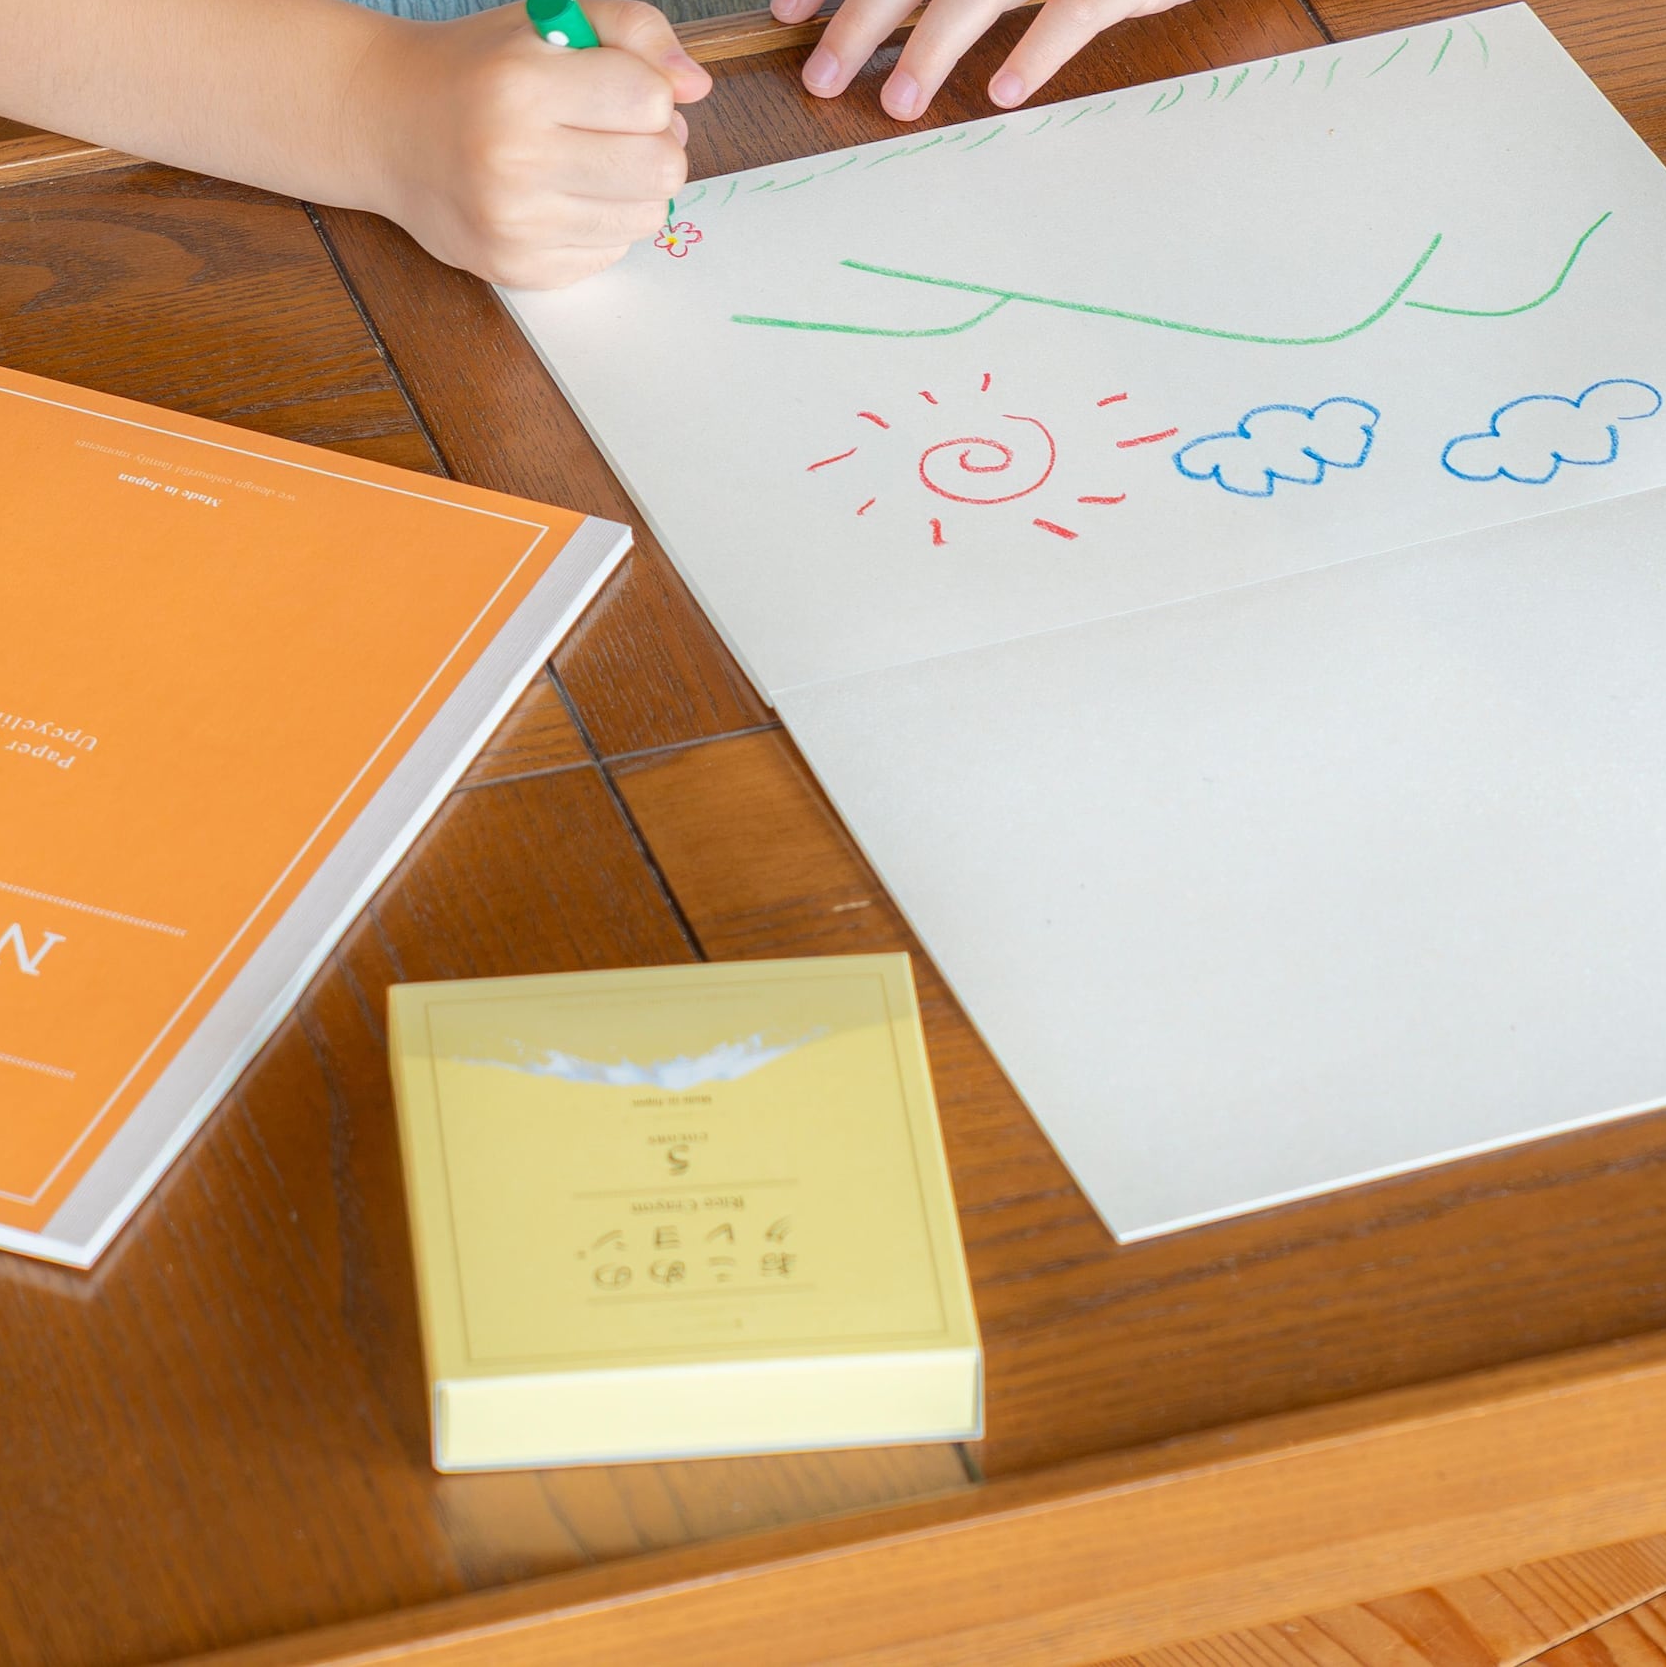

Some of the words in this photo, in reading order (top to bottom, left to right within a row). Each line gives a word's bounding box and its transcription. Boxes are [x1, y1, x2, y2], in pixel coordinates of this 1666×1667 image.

[117, 472, 162, 492] Japan
[164, 485, 180, 496] in
[181, 490, 223, 508] Made
[5, 739, 77, 769] Paper
[666, 1144, 691, 1177] 5
[593, 1251, 798, 1292] おこめの
